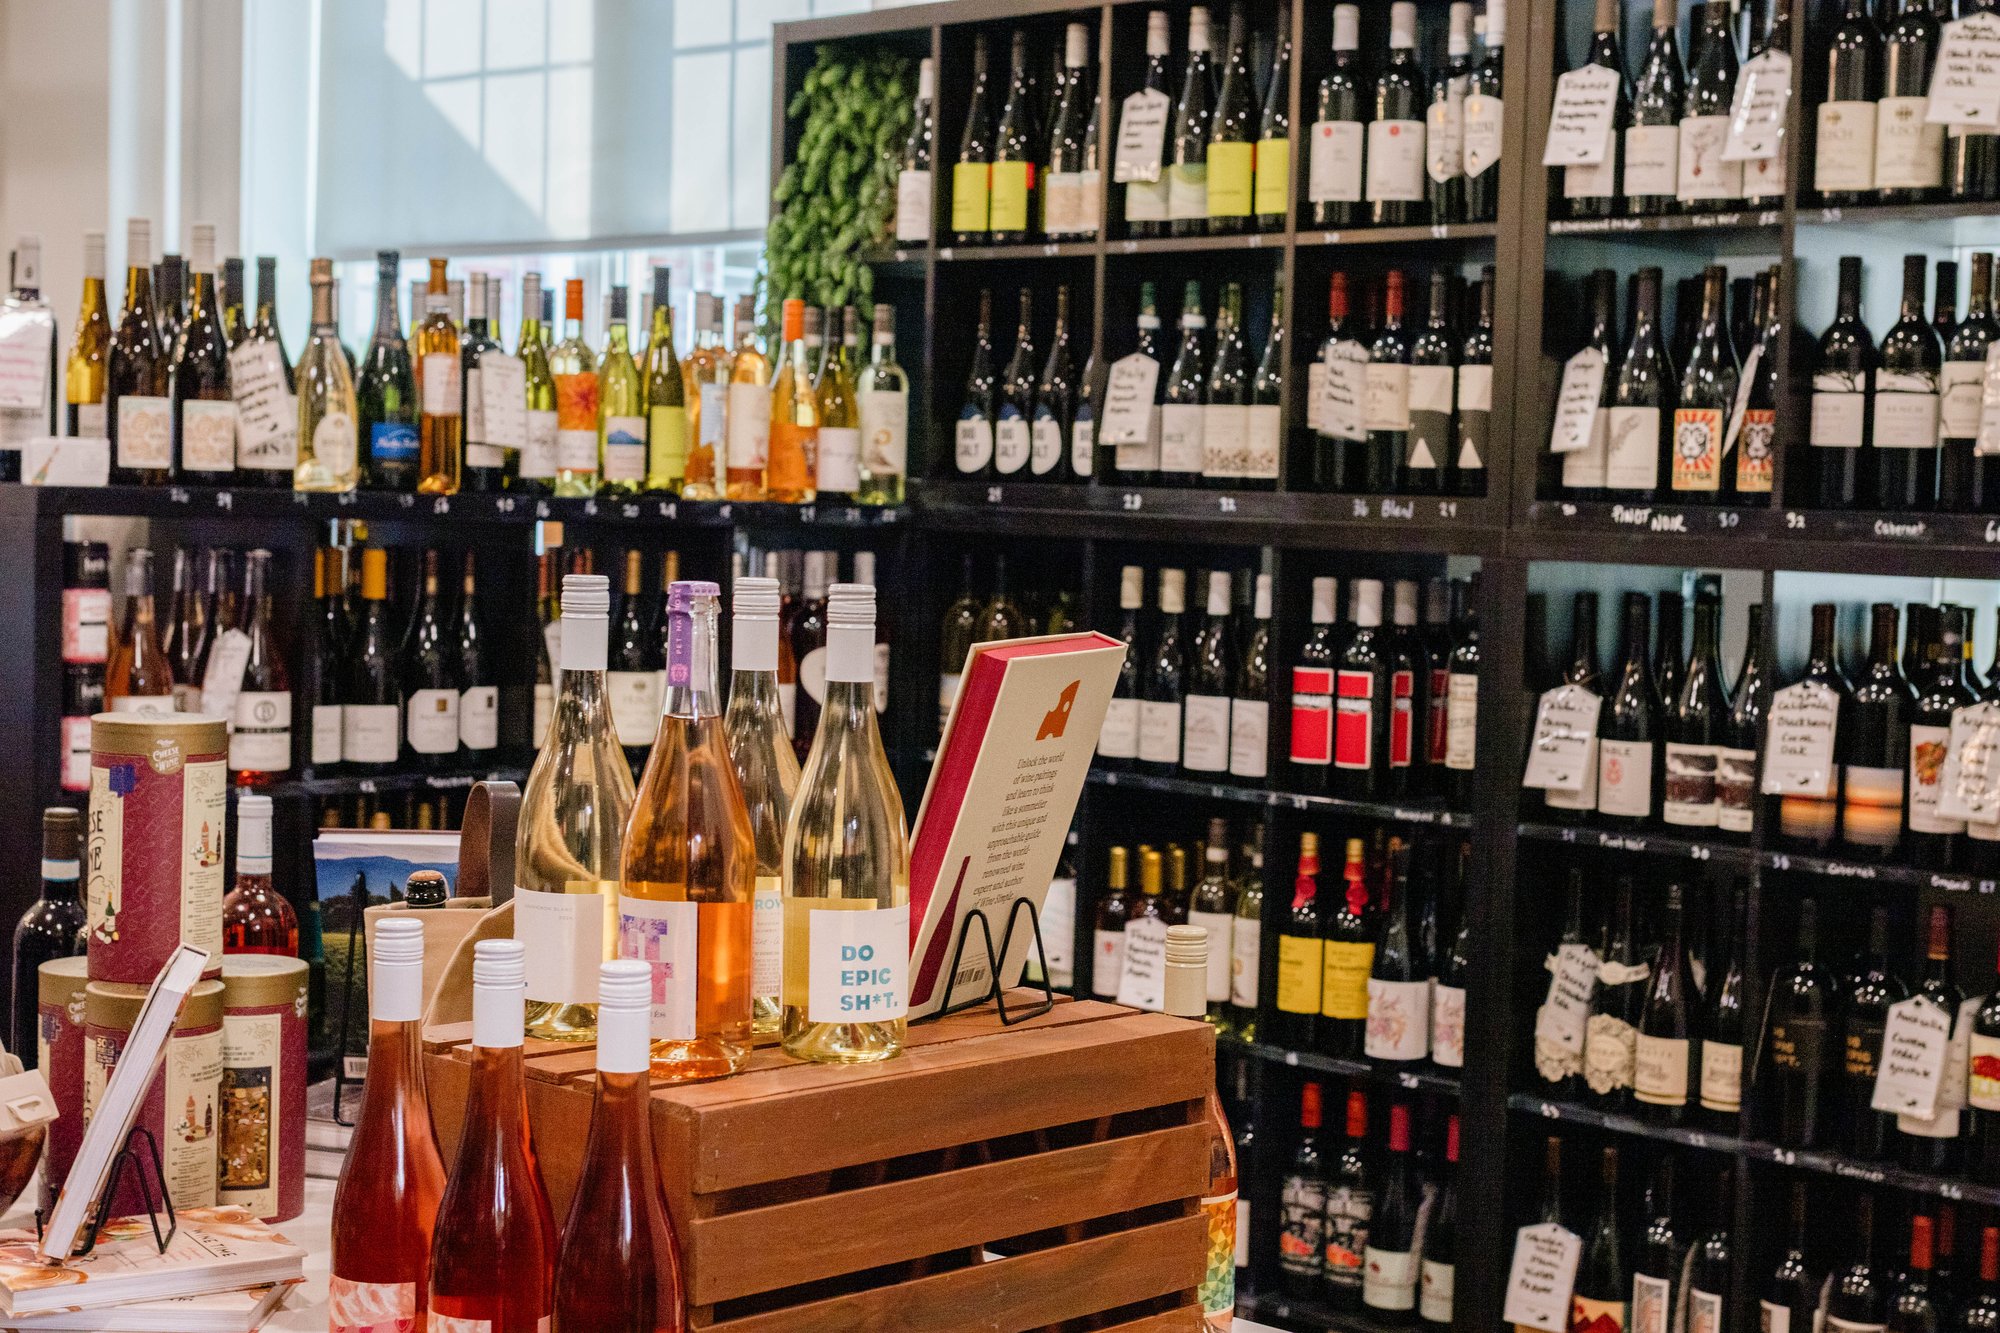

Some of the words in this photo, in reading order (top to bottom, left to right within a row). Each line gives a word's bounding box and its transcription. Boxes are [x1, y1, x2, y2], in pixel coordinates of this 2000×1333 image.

[1985, 519, 2000, 543] 6
[1017, 756, 1038, 769] Unlock
[1038, 755, 1048, 766] the
[1048, 751, 1065, 763] world
[1021, 773, 1035, 783] wine
[991, 821, 1005, 834] with
[1005, 818, 1017, 831] this
[1017, 816, 1036, 830] unique
[1036, 812, 1049, 824] and
[987, 831, 1026, 850] approachable
[1025, 828, 1042, 843] guide
[987, 852, 1002, 864] from
[1002, 849, 1012, 860] the
[982, 863, 1012, 879] renowned
[1011, 861, 1025, 872] wine
[973, 884, 992, 897] expert
[992, 879, 1005, 891] and
[1004, 875, 1024, 888] author
[980, 896, 995, 908] Wine
[841, 945, 874, 961] DO
[841, 968, 891, 986] EPIC
